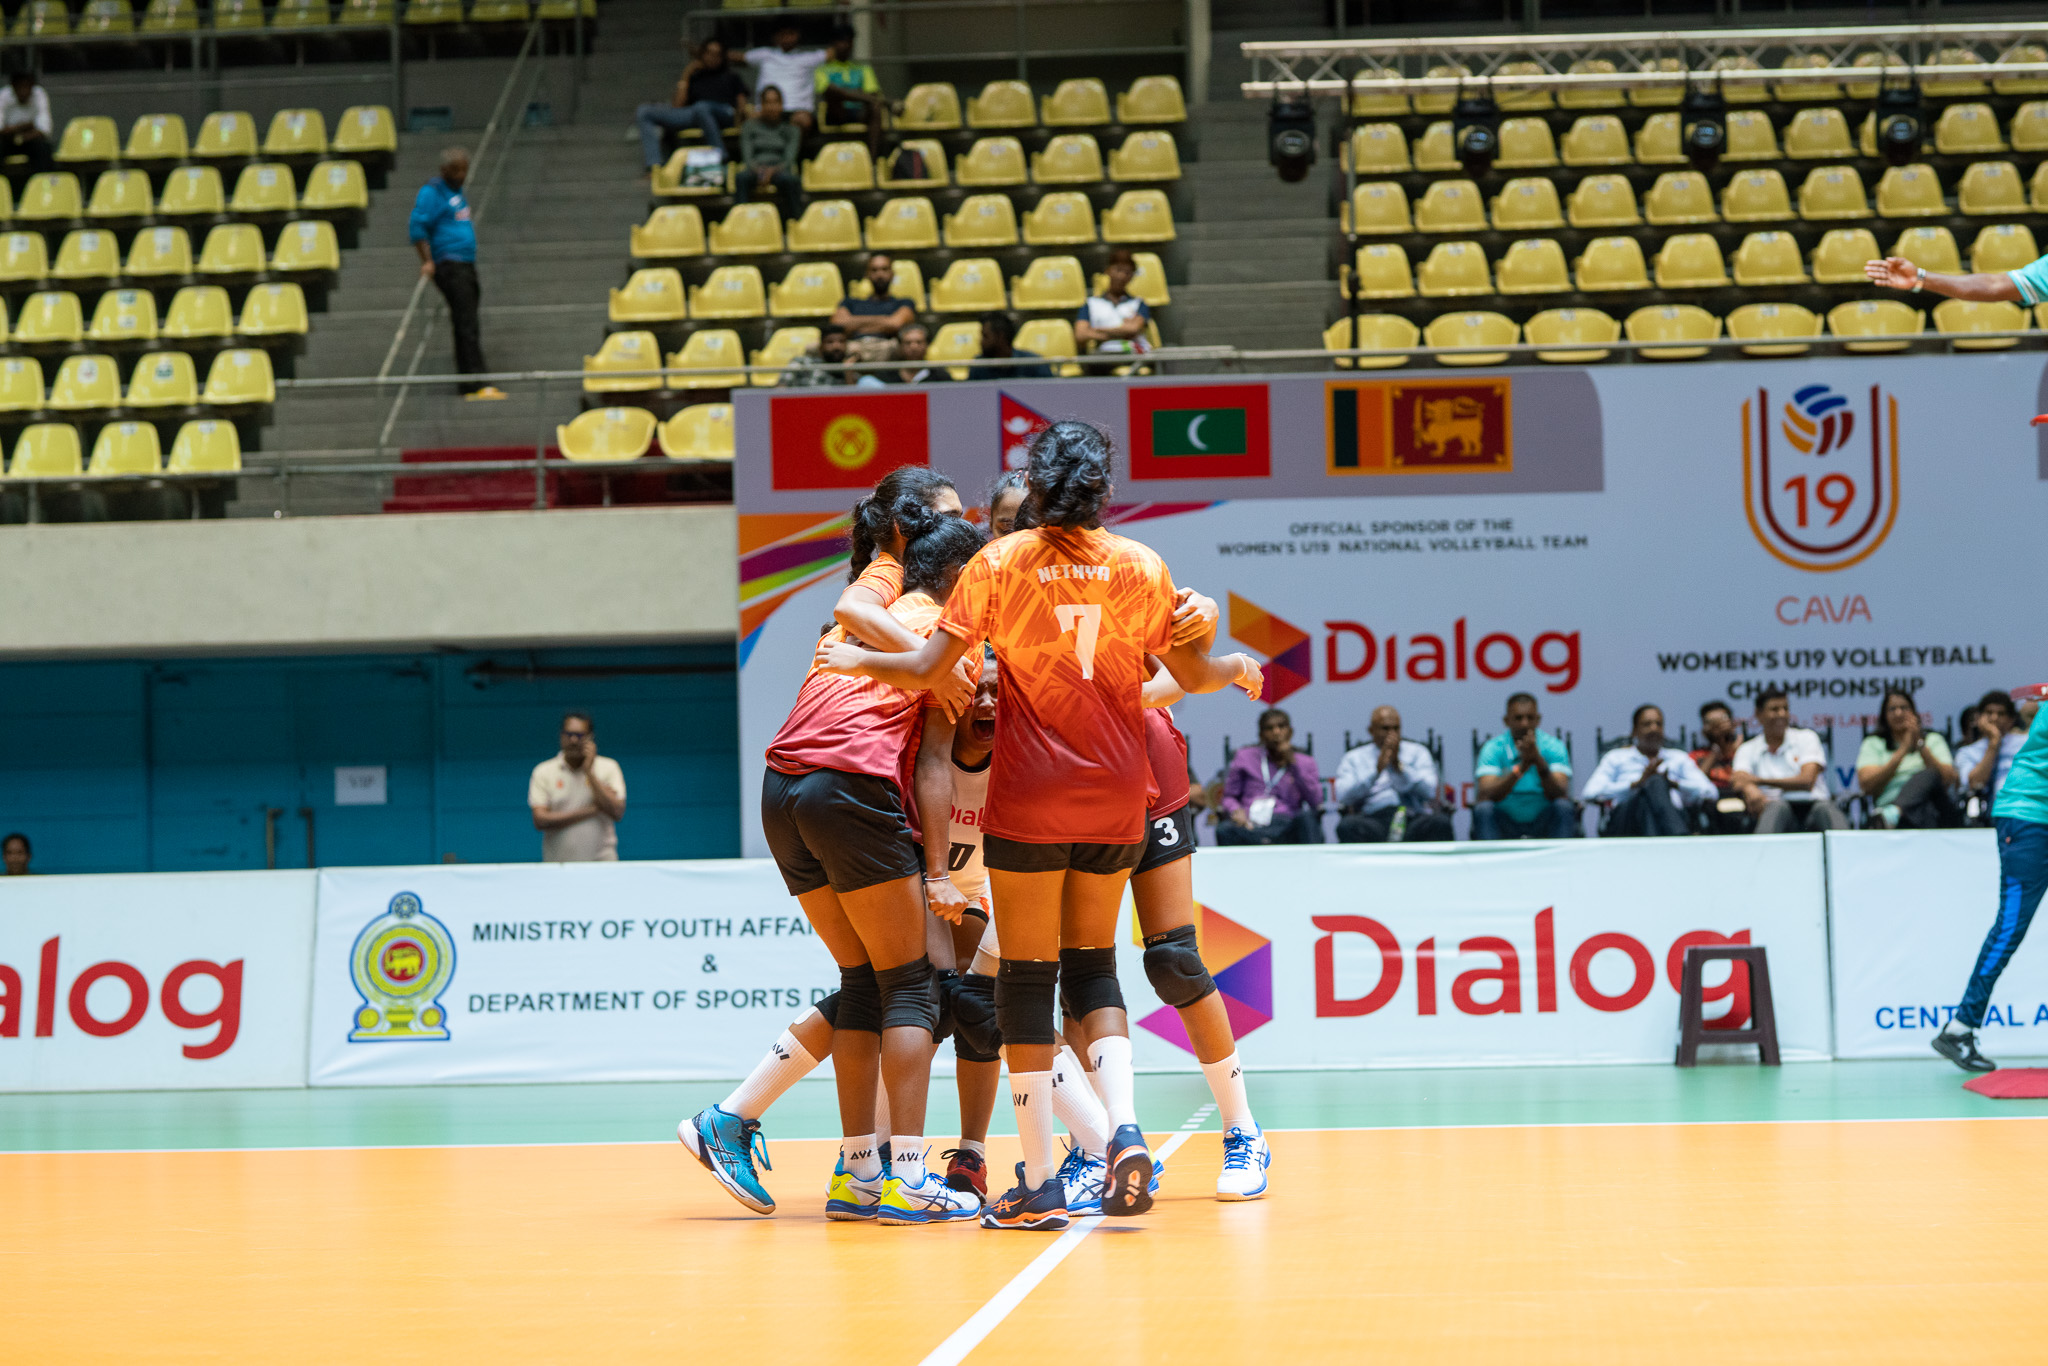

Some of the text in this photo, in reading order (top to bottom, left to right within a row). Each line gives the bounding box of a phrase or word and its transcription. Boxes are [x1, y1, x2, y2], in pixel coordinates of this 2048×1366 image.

[1289, 518, 1513, 536] OFFICIAL SPONSOR OF THE
[1218, 535, 1588, 556] WOMEN'S U19 NATIONAL VOLLEYBALL TEAM
[1776, 595, 1872, 625] CAVA
[1054, 604, 1101, 680] 7
[1324, 616, 1581, 694] Dialog
[1657, 645, 1995, 671] WOMEN'S U19 VOLLEYBALL
[1154, 816, 1179, 846] 3
[472, 916, 818, 941] MINISTRY OF YOUTH AFFAI
[701, 954, 718, 973] &
[1311, 906, 1751, 1030] Dialog
[468, 990, 645, 1013] DEPARTMENT
[653, 990, 687, 1010] OF
[696, 988, 801, 1009] SPORTS
[1875, 1003, 2025, 1029] CENTAL
